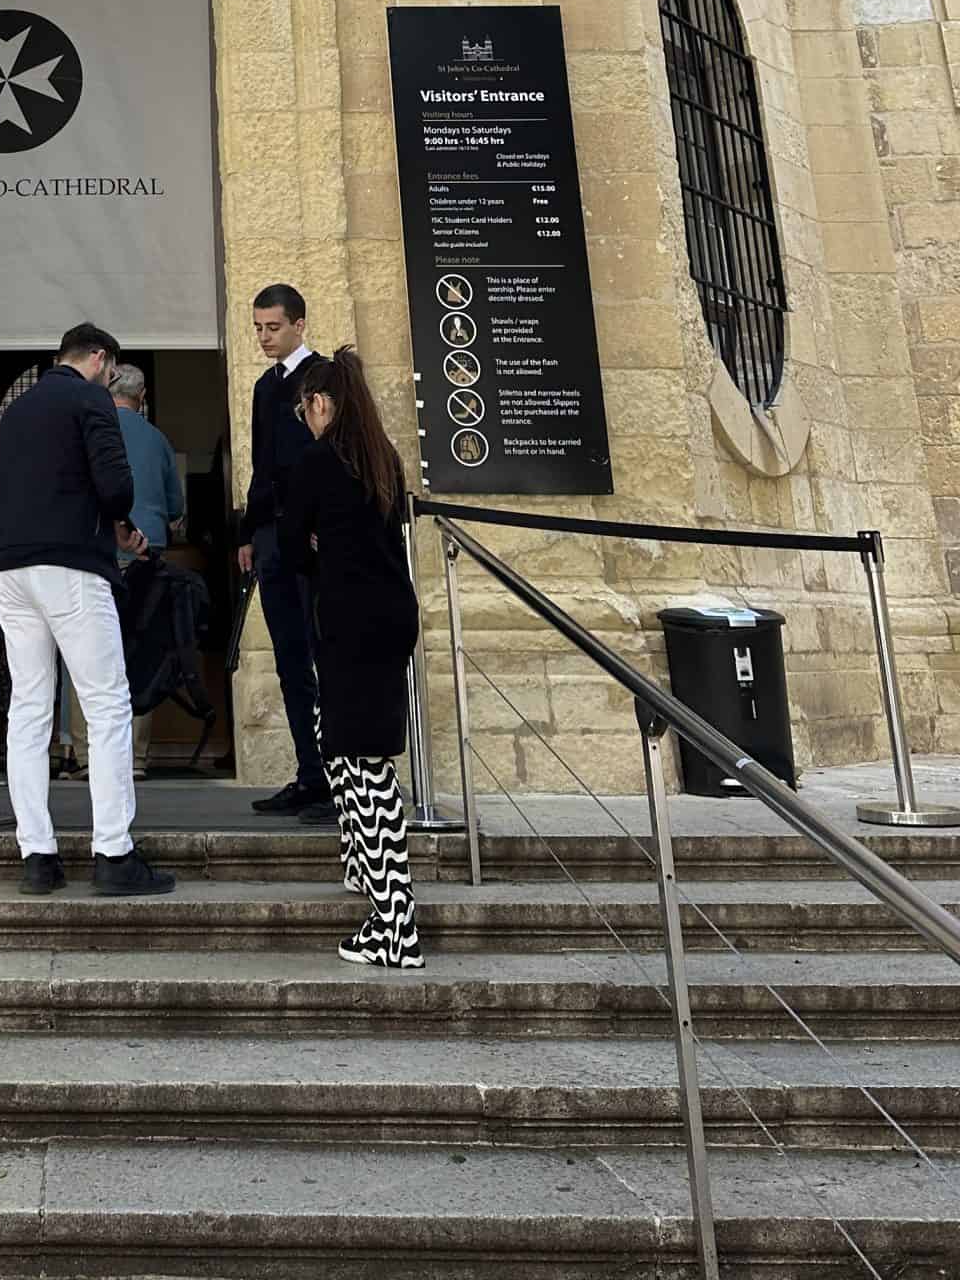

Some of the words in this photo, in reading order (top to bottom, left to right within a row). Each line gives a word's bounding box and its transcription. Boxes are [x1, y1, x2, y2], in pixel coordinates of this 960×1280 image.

[480, 90, 545, 102] Entrance
[422, 111, 450, 119] Visiting
[423, 126, 460, 136] Mondays
[472, 126, 512, 136] Saturdays
[424, 137, 443, 145] 9:00
[444, 137, 458, 145] hrs
[466, 137, 489, 145] 16:45
[490, 137, 505, 145] hrs
[532, 197, 549, 205] Free
[435, 256, 460, 264] Please
[513, 277, 530, 285] place
[504, 327, 534, 335] provided
[496, 358, 507, 366] The
[521, 358, 529, 366] of
[542, 358, 559, 366] flash
[553, 399, 580, 407] Slippers
[524, 408, 559, 416] purchased
[504, 438, 538, 446] Backpacks
[548, 438, 557, 446] be
